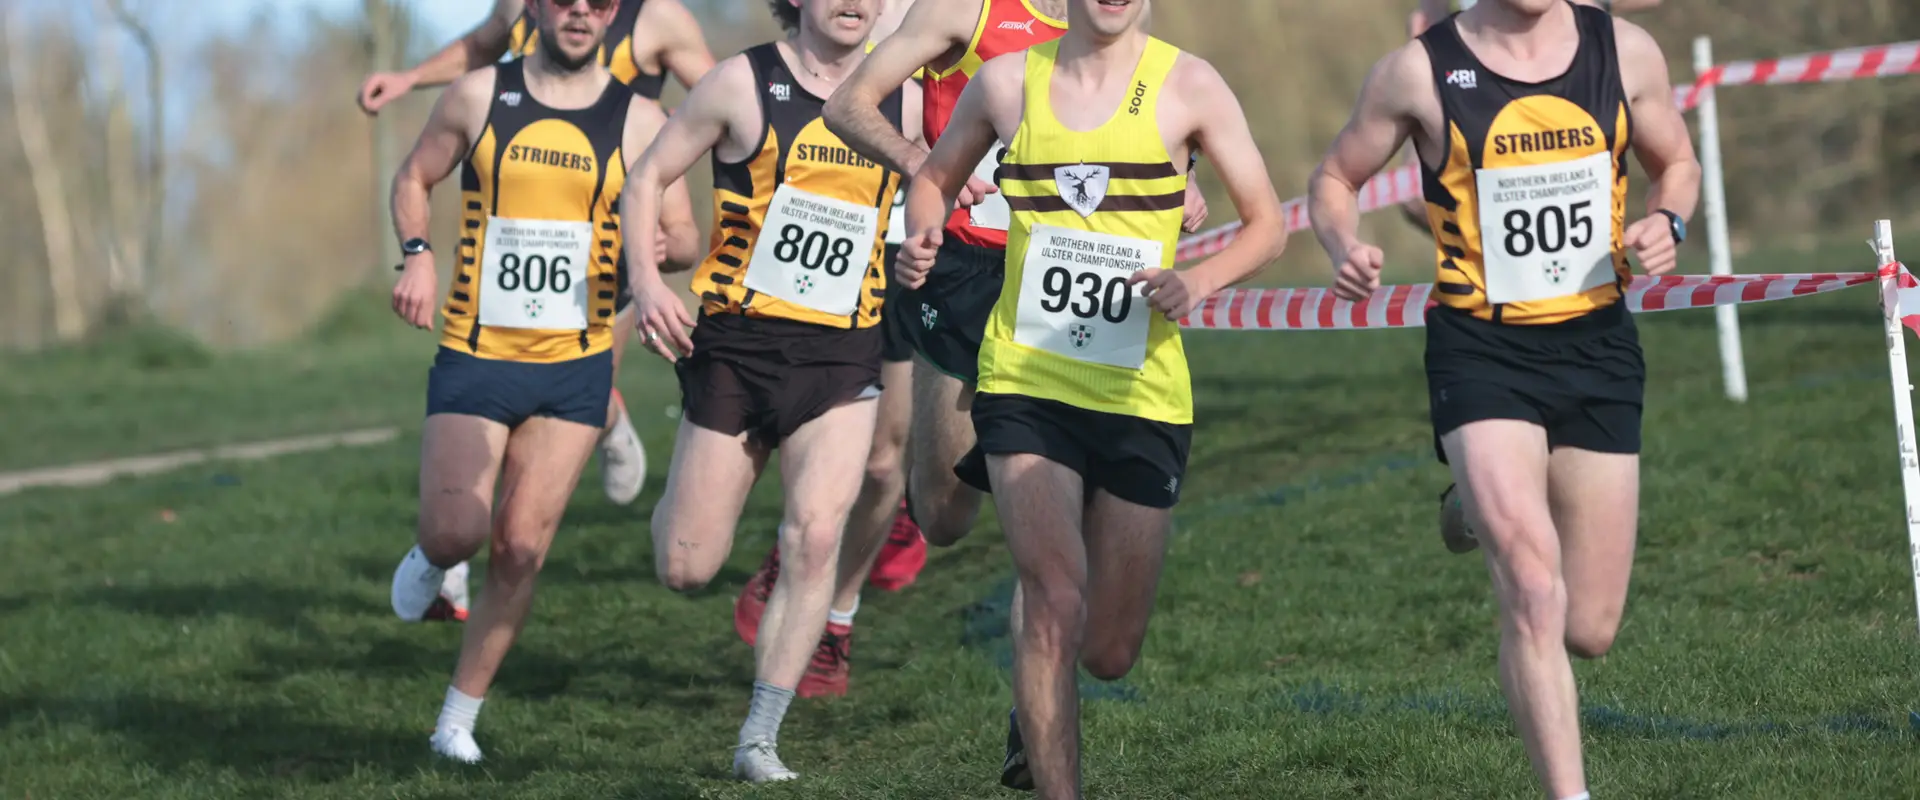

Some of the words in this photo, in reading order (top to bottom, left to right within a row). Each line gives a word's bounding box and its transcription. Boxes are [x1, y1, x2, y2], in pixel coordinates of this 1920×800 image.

[1129, 80, 1147, 116] soar
[1493, 126, 1596, 155] STRIDERS
[509, 145, 592, 172] STRIDERS
[1493, 190, 1527, 203] ULSTER
[1529, 178, 1599, 200] CHAMPIONSHIPS
[1498, 175, 1547, 189] NORTHERN
[1549, 170, 1586, 183] IRELAND
[781, 205, 809, 220] ULSTER
[809, 213, 866, 235] CHAMPIONSHIPS
[789, 196, 828, 214] NORTHERN
[829, 207, 859, 222] IRELAND
[1503, 200, 1593, 257] 805
[773, 223, 854, 277] 808
[1041, 247, 1073, 261] ULSTER
[1075, 252, 1146, 272] CHAMPIONSHIPS
[1050, 235, 1095, 252] NORTHERN
[1097, 243, 1133, 259] IRELAND
[1134, 249, 1141, 259] &
[497, 252, 571, 294] 806
[1040, 266, 1132, 323] 930
